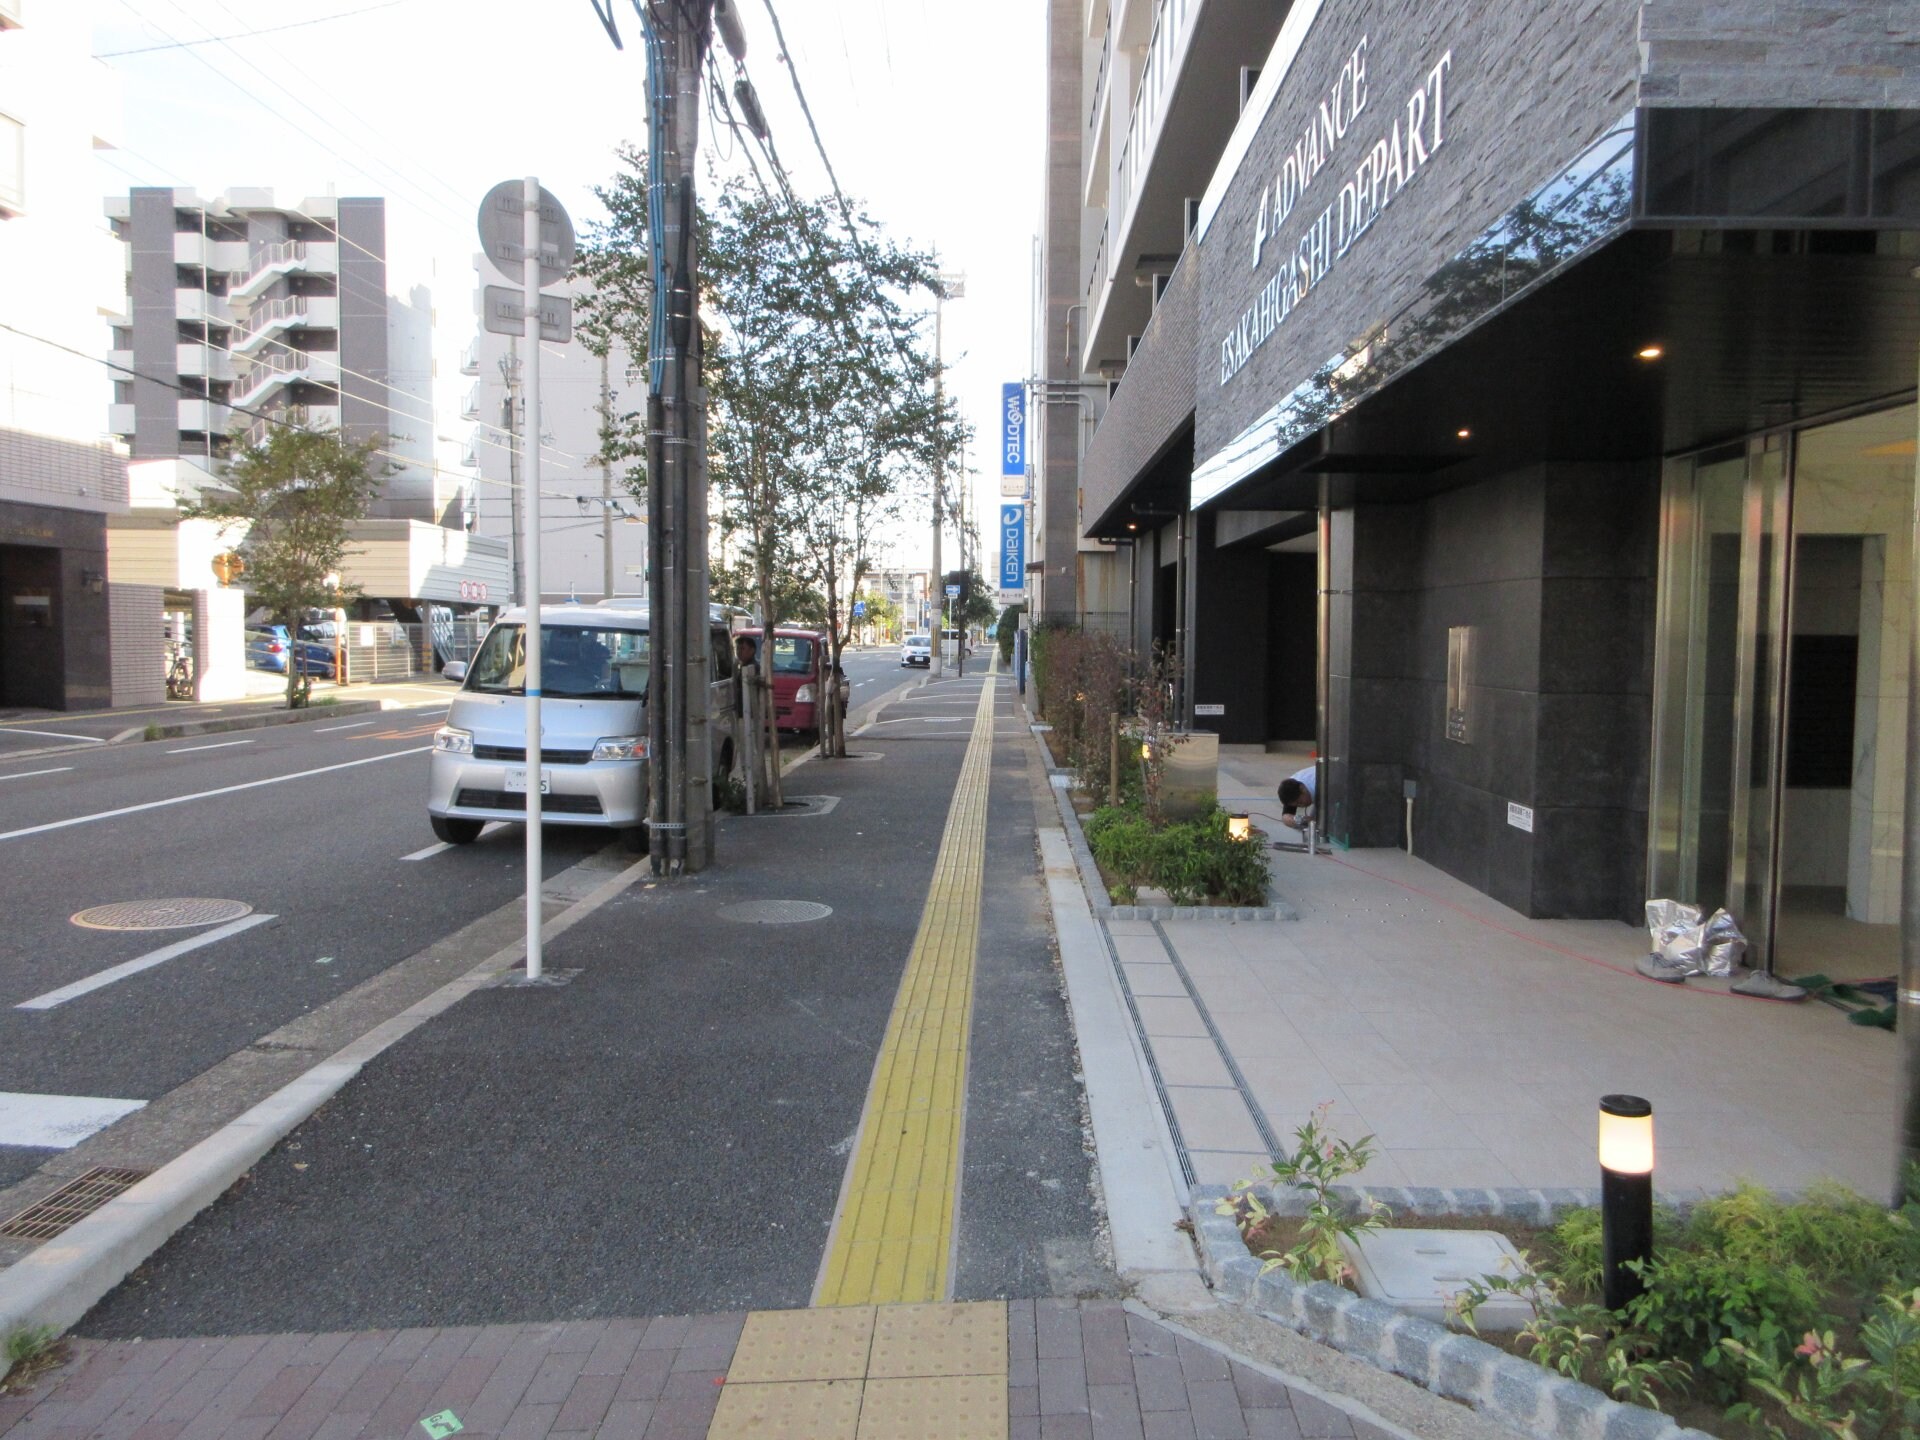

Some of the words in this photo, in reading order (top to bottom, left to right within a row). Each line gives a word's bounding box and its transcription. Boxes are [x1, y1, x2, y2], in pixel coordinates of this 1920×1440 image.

[1220, 201, 1334, 387] ESAKAHIGASHI
[1336, 48, 1453, 260] DEPART
[1271, 33, 1369, 237] ADVANCE
[1006, 394, 1024, 464] WOODTEC
